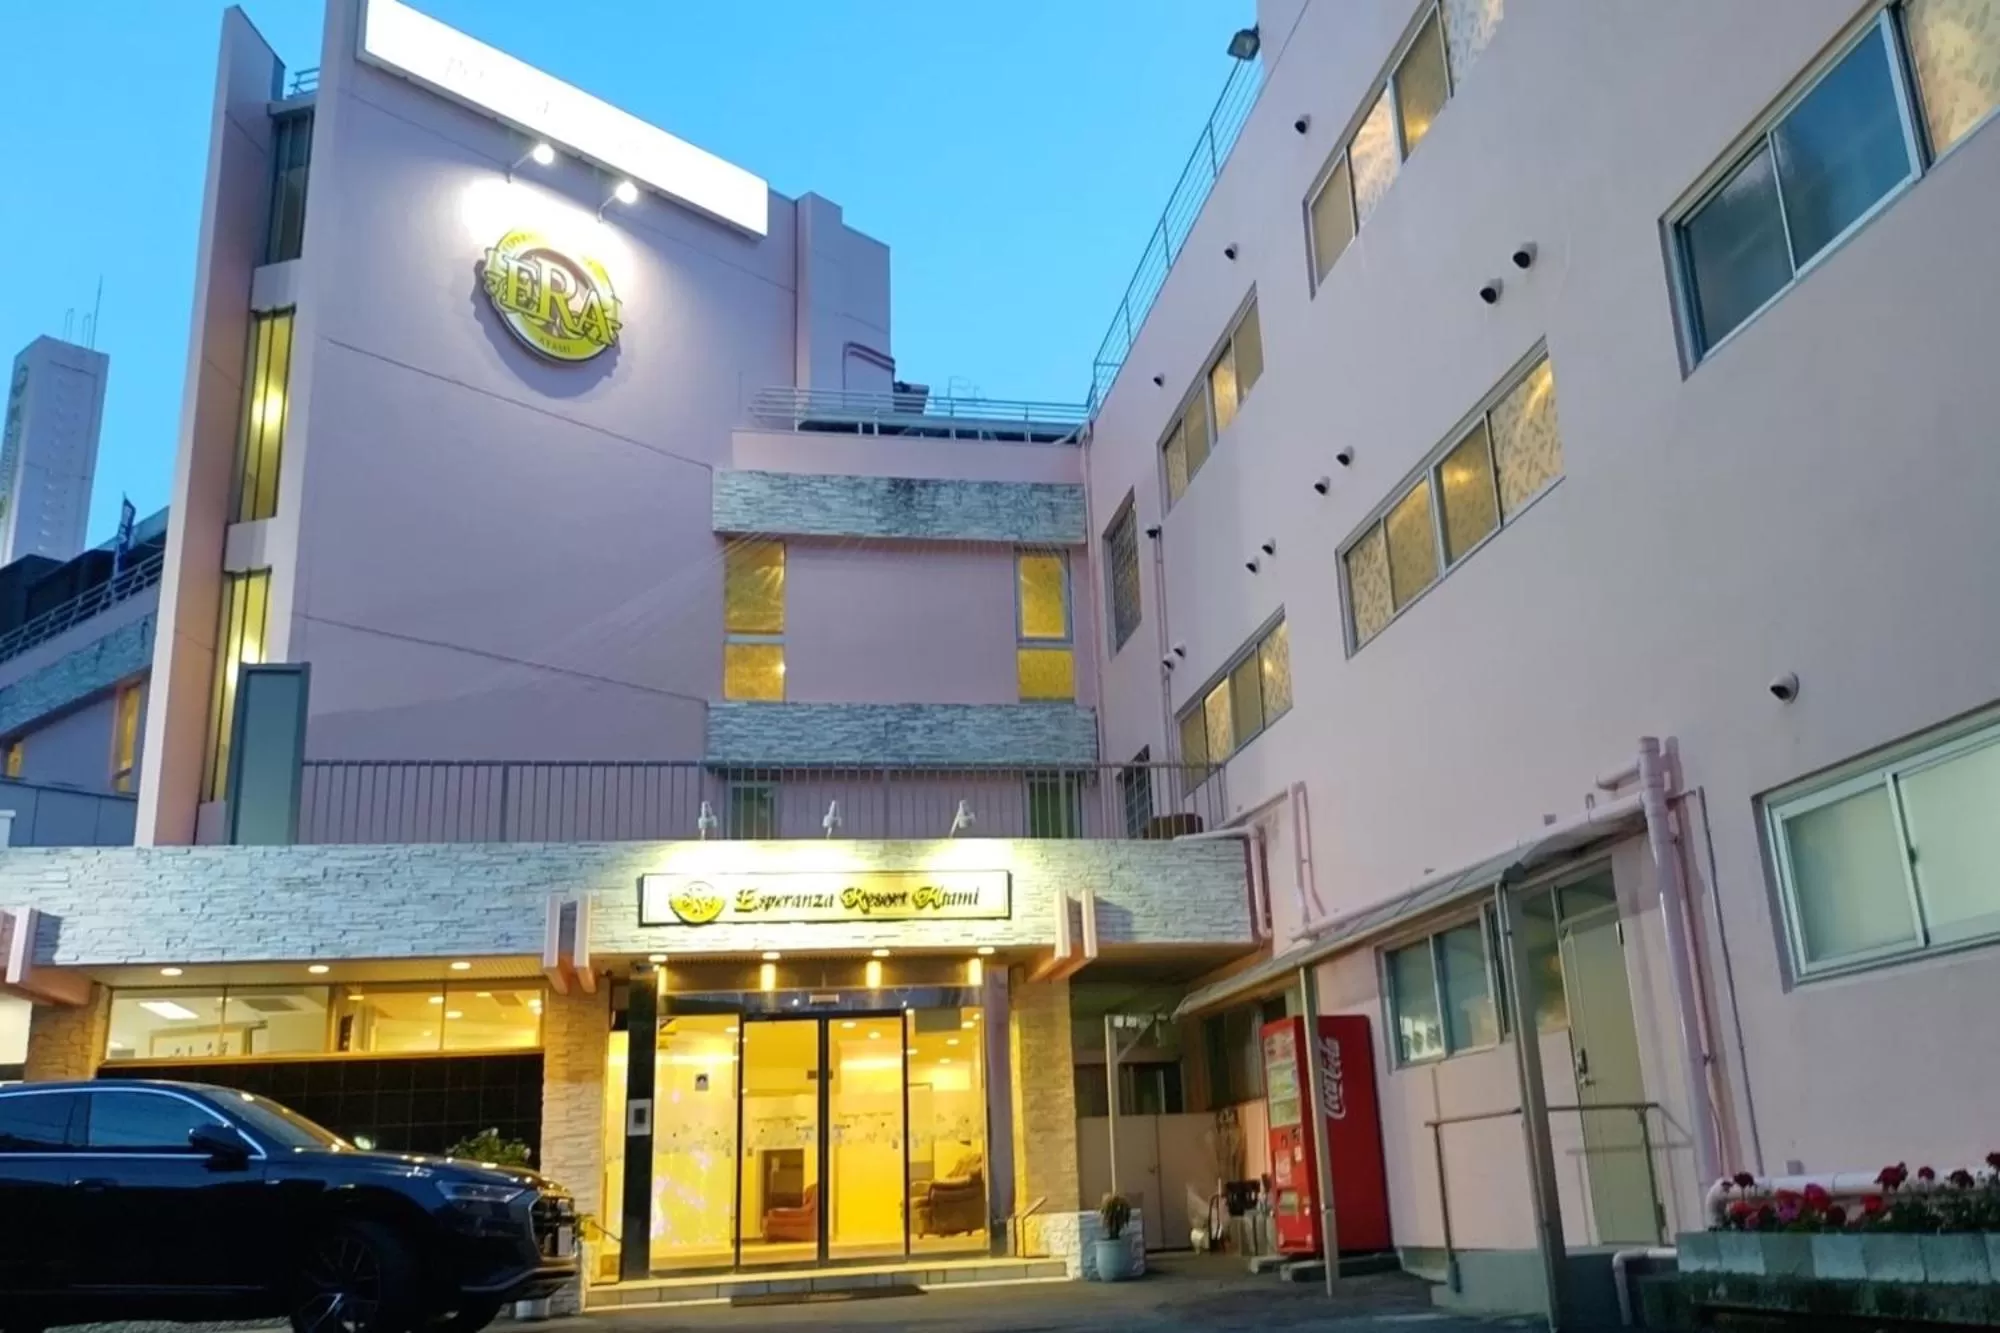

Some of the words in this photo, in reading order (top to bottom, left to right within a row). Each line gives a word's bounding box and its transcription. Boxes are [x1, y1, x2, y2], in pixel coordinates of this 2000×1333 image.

[502, 254, 614, 347] ERA
[734, 887, 834, 913] Esperanza
[840, 887, 908, 914] Resort
[911, 885, 980, 911] Atami
